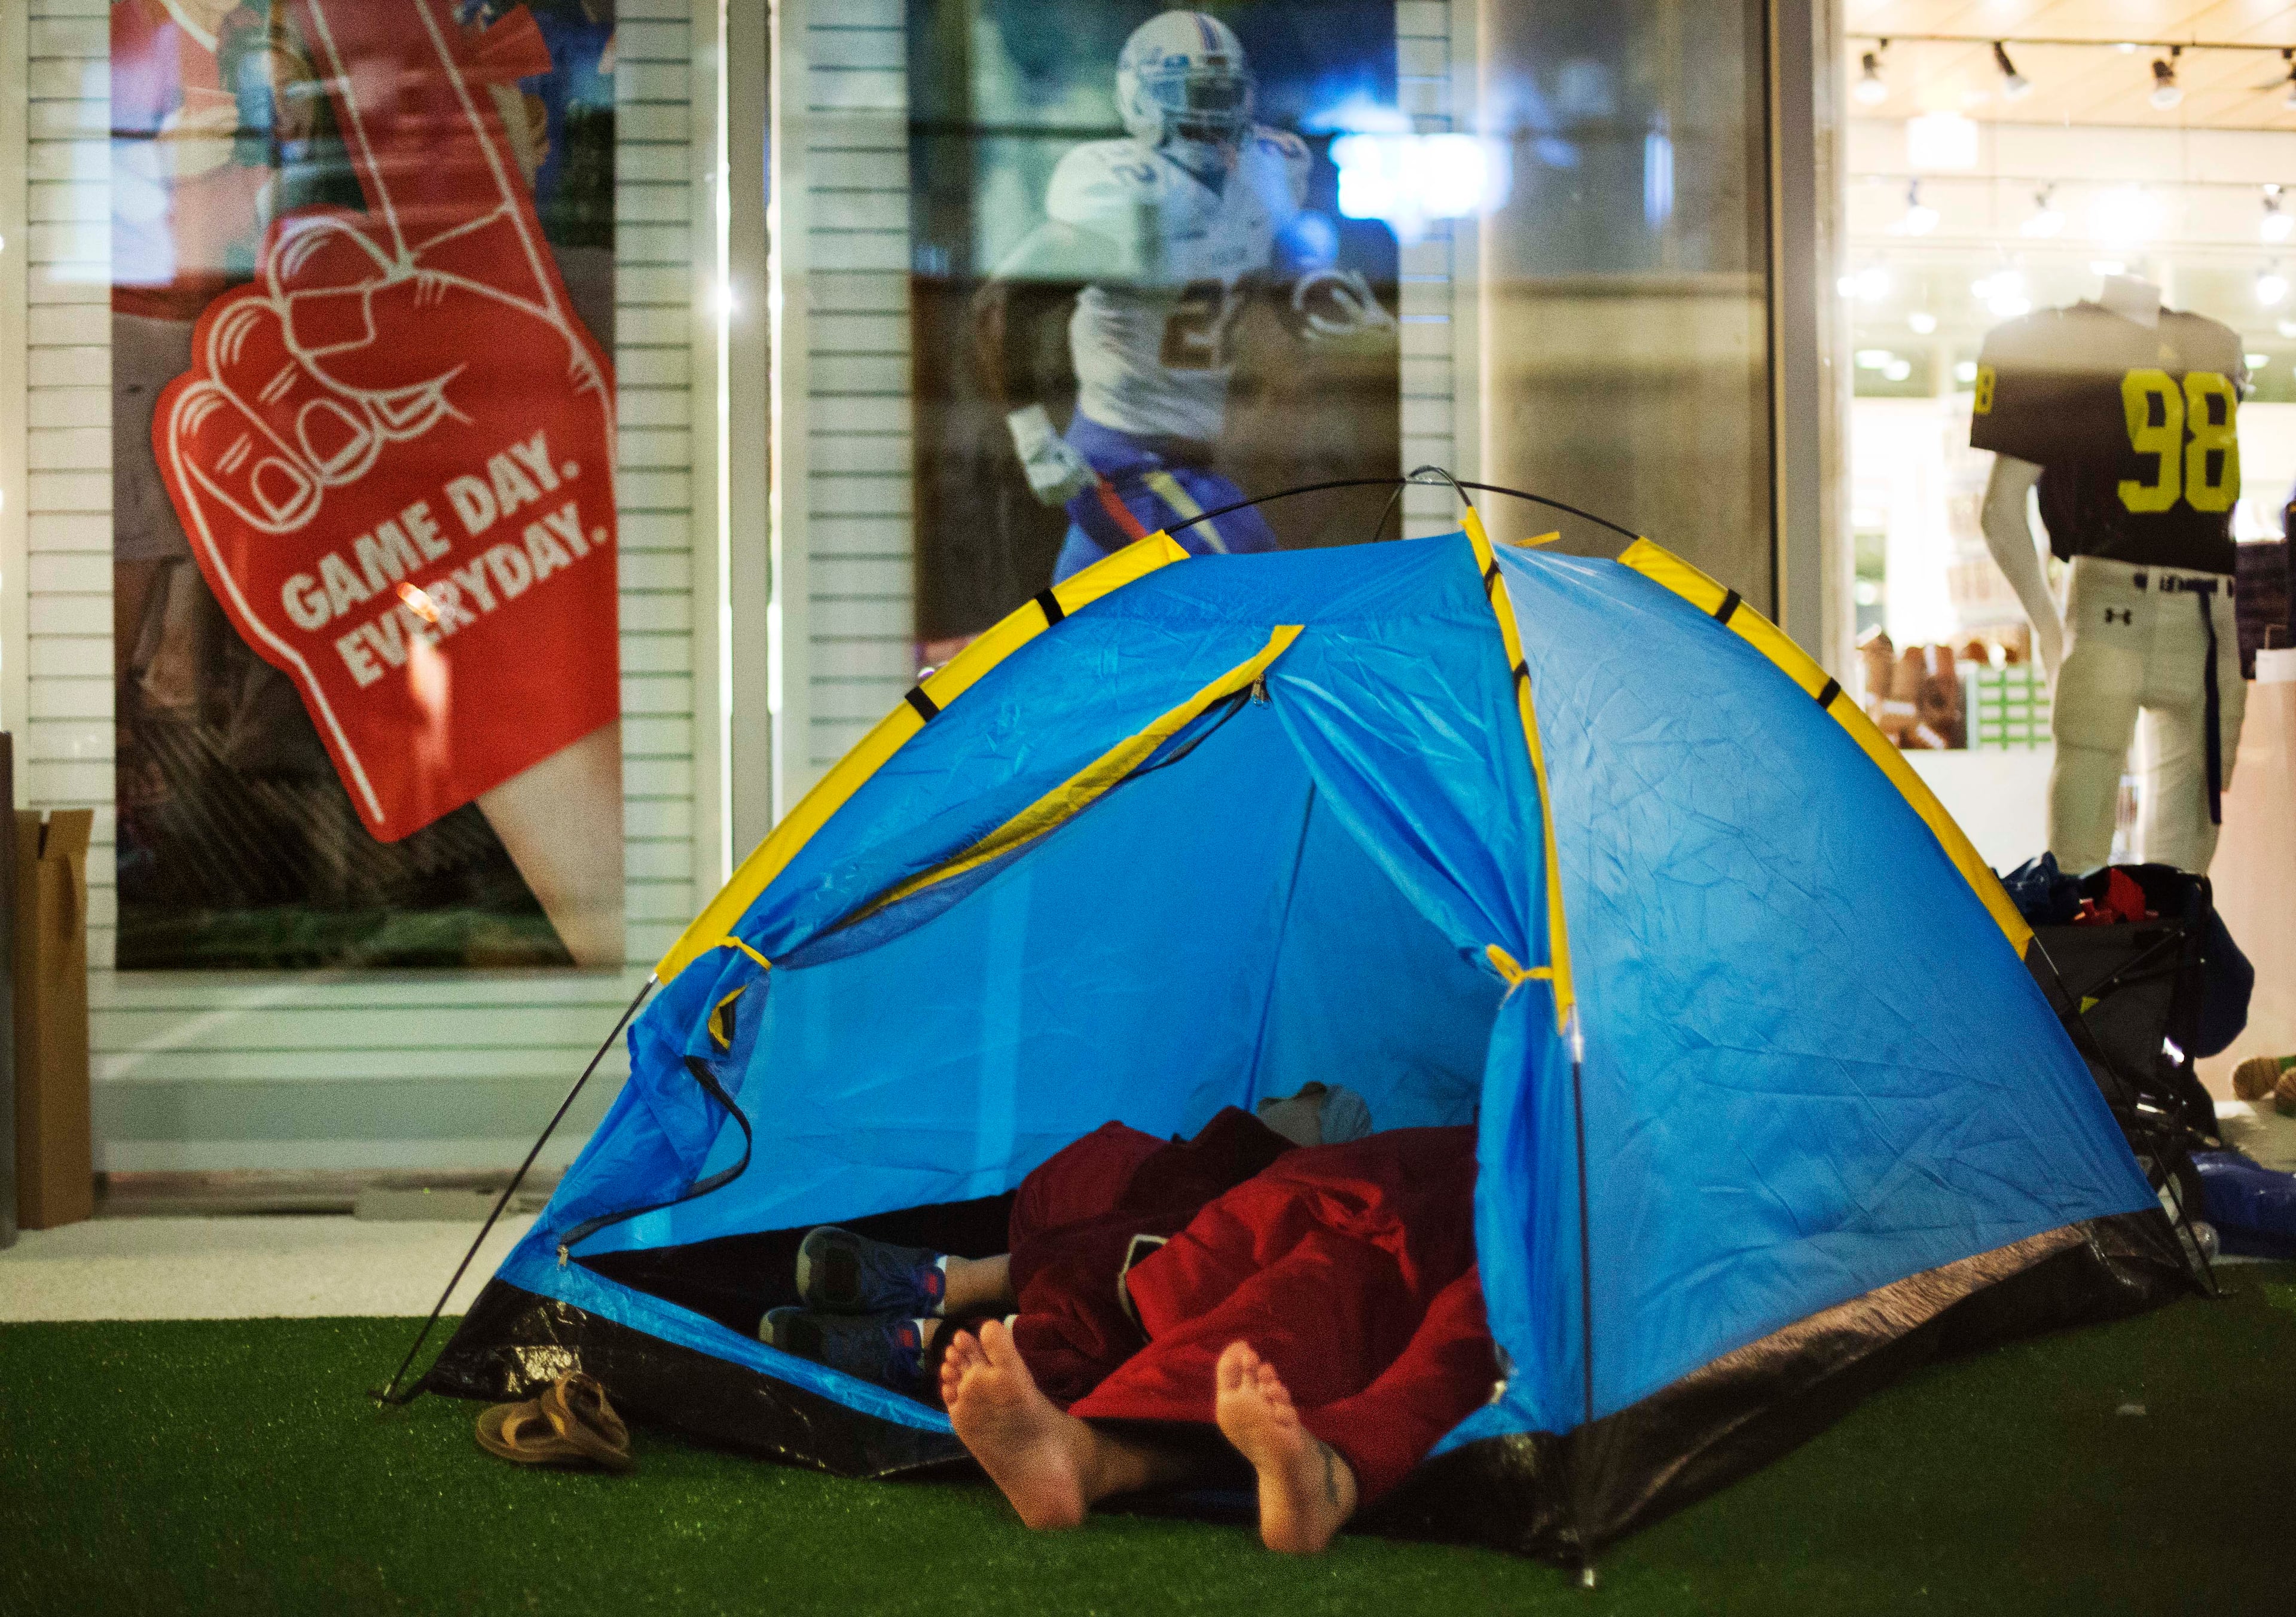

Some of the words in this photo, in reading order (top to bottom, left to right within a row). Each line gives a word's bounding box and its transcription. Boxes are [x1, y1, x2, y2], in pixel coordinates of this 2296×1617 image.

[282, 502, 450, 631] GAME
[444, 431, 579, 536] DAY.
[2118, 369, 2240, 512] 98
[335, 503, 607, 687] EVERYDAY.
